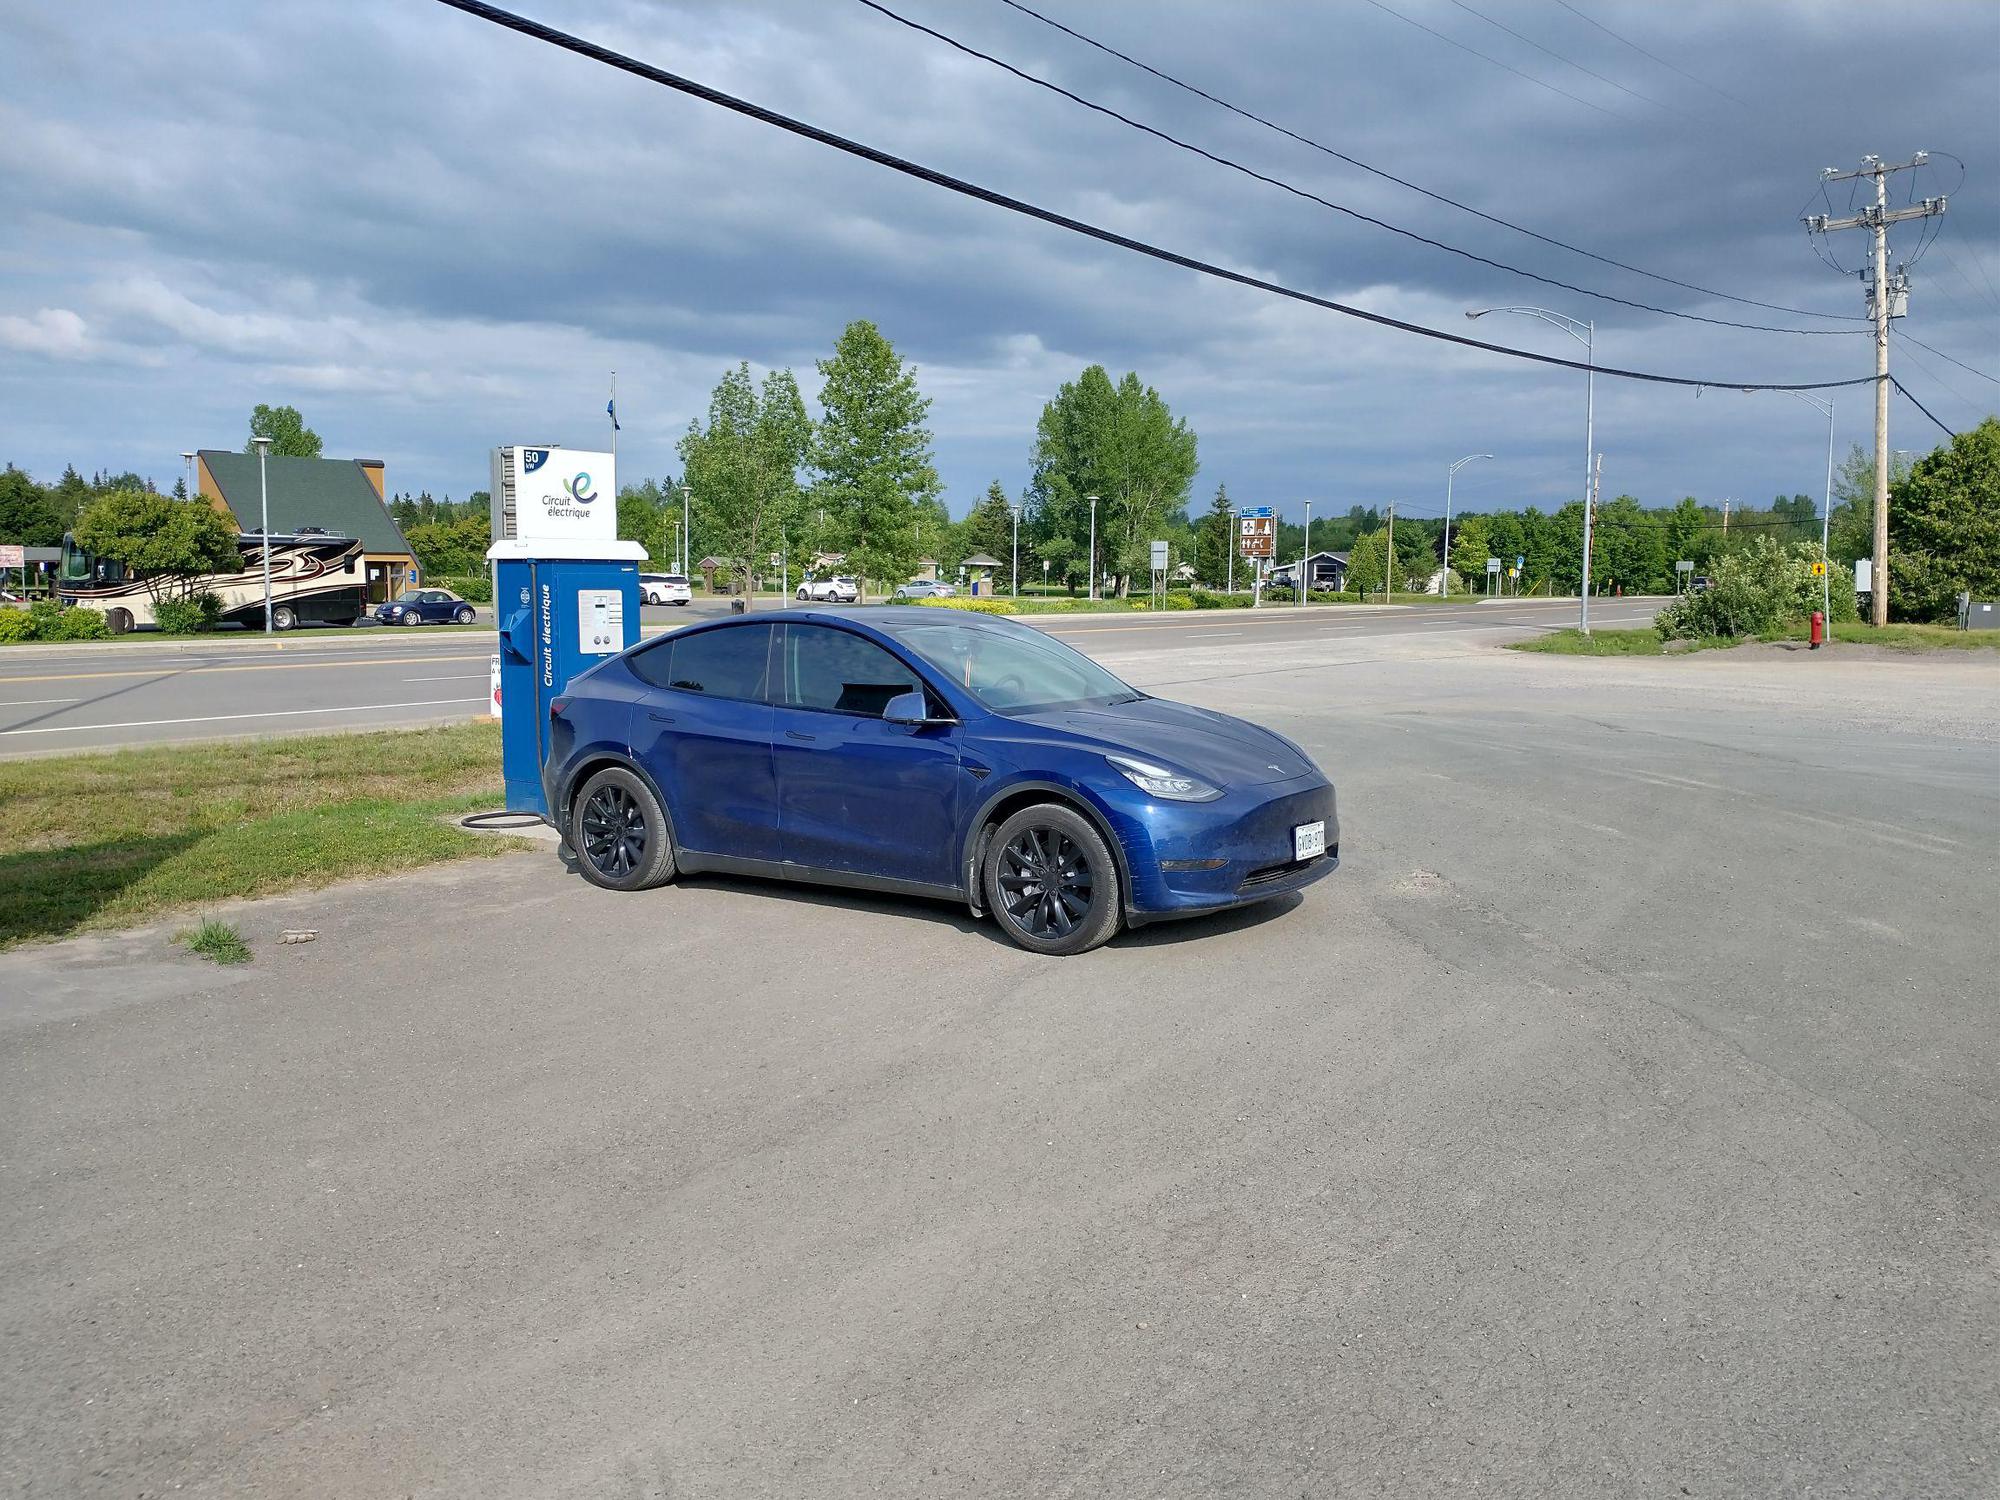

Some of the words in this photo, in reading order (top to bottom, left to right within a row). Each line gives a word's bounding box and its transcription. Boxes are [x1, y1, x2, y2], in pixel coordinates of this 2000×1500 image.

[525, 451, 539, 463] 50
[542, 495, 571, 506] Circuit
[547, 506, 591, 519] électrique
[541, 584, 552, 644] électrique
[543, 646, 553, 688] Circuit
